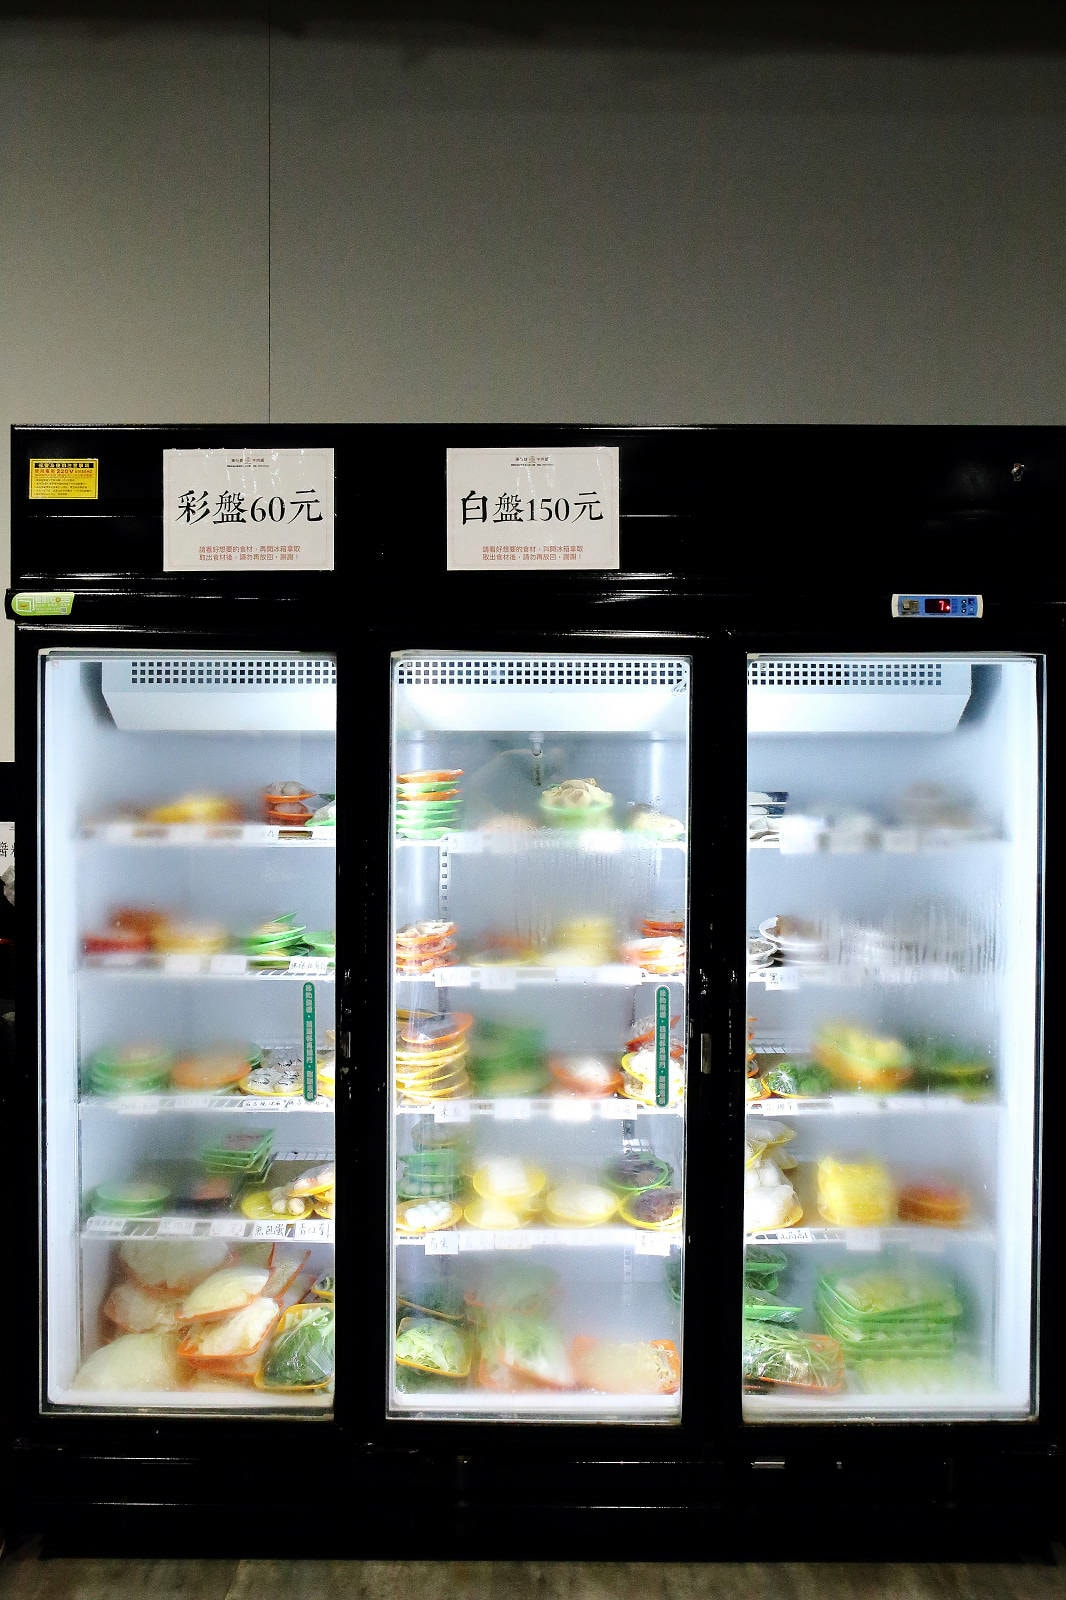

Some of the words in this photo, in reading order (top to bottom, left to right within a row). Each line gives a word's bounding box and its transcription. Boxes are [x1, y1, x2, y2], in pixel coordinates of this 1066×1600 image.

[175, 489, 324, 526] 彩盤60元
[460, 490, 604, 526] 白盤150元
